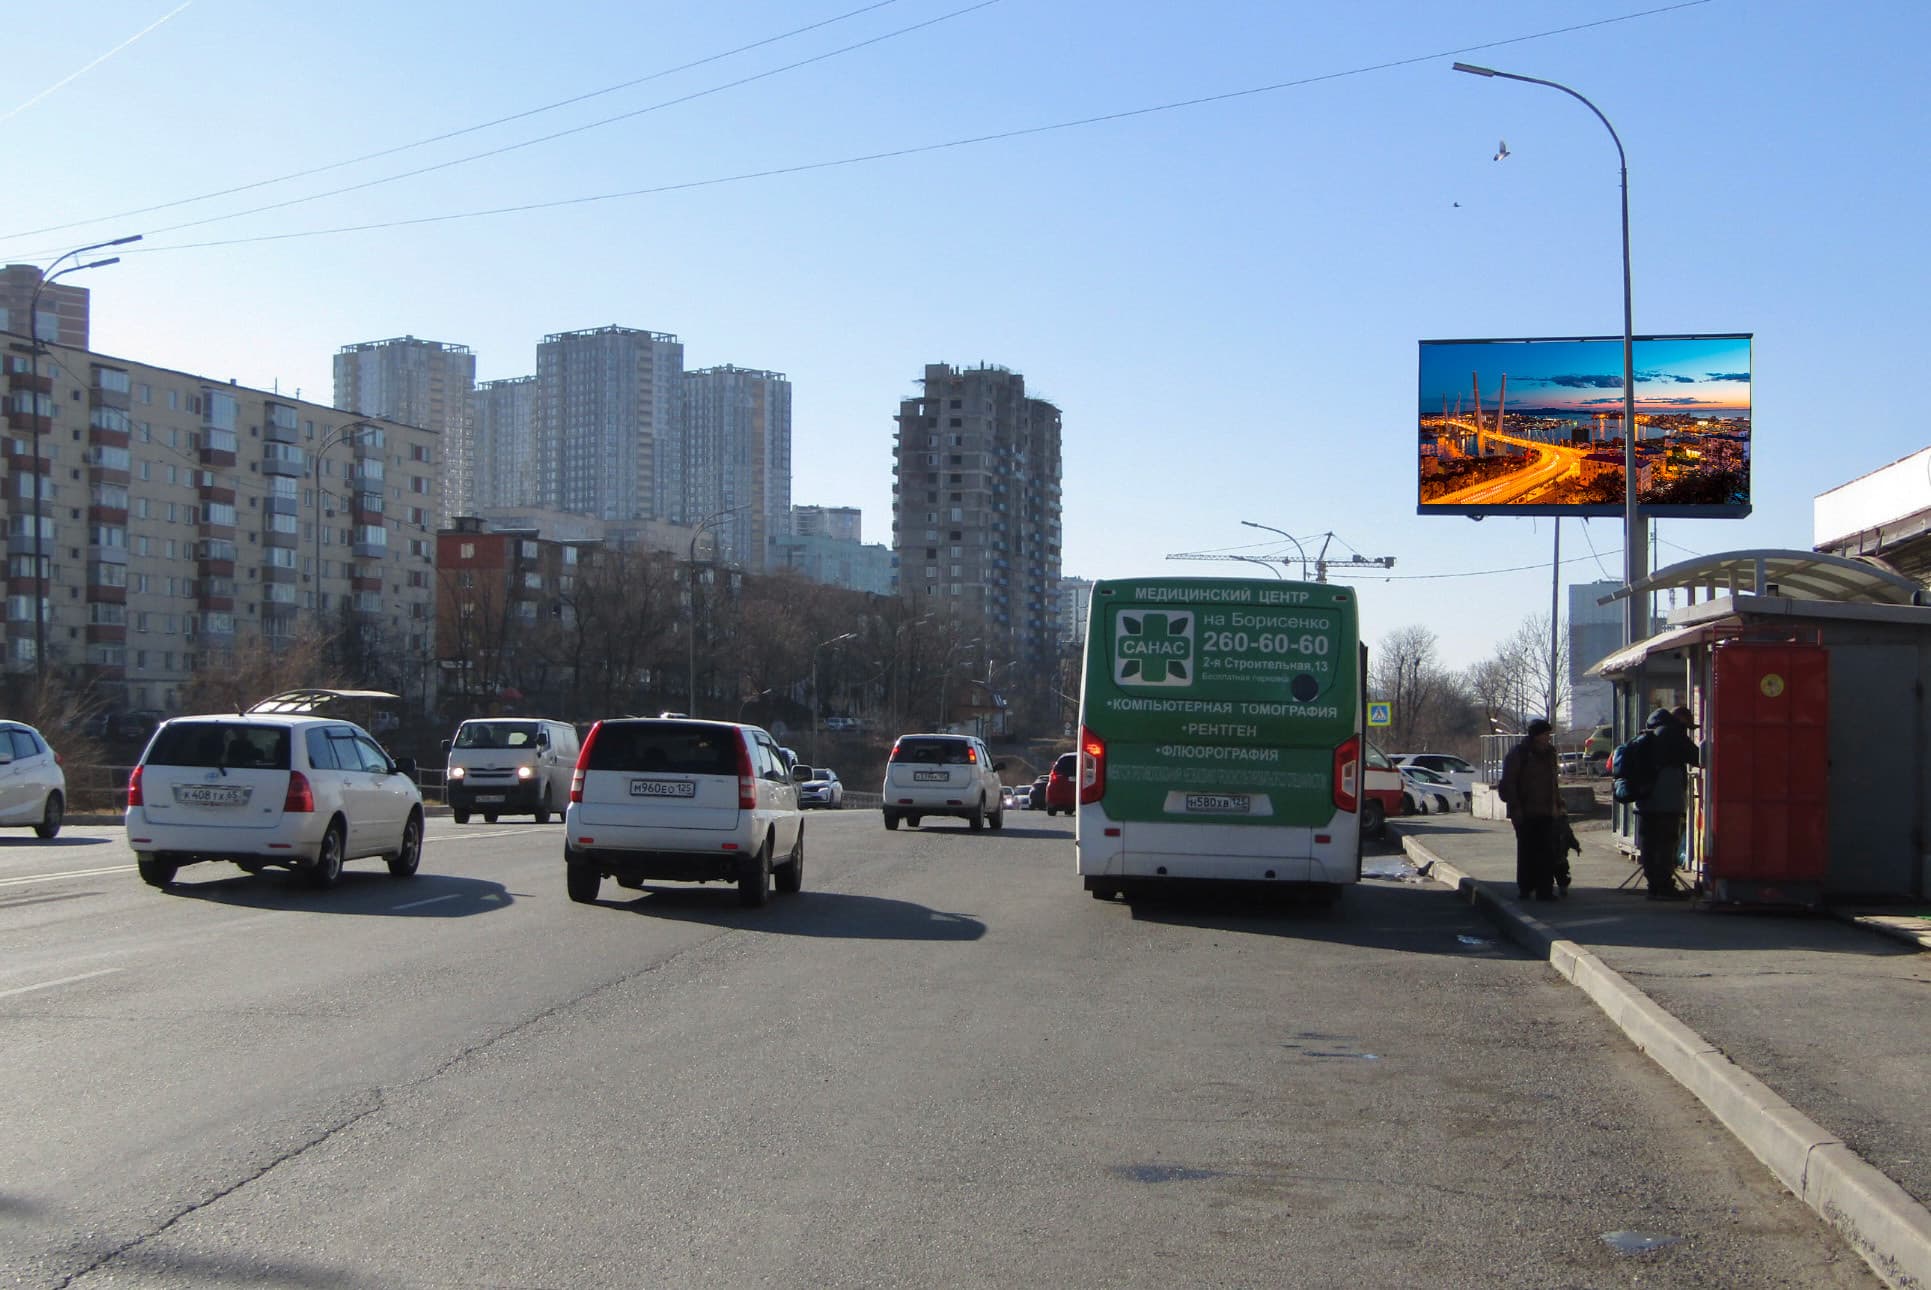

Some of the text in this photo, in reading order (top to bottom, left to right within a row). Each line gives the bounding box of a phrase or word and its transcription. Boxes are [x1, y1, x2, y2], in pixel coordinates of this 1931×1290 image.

[1135, 587, 1310, 604] МЕДИЦИНСКИЙ ЦЕНТР
[1203, 612, 1331, 630] на Борисенко
[1122, 640, 1186, 655] САНАС
[1202, 632, 1330, 656] 260-60-60
[1202, 656, 1221, 668] 2-я
[1112, 699, 1338, 719] КОМПЬЮТЕРНАЯ ТОМОГРАФИЯ
[1188, 722, 1257, 737] РЕНТГЕН
[1160, 745, 1279, 761] ФЛЮОРОГРАФИЯ
